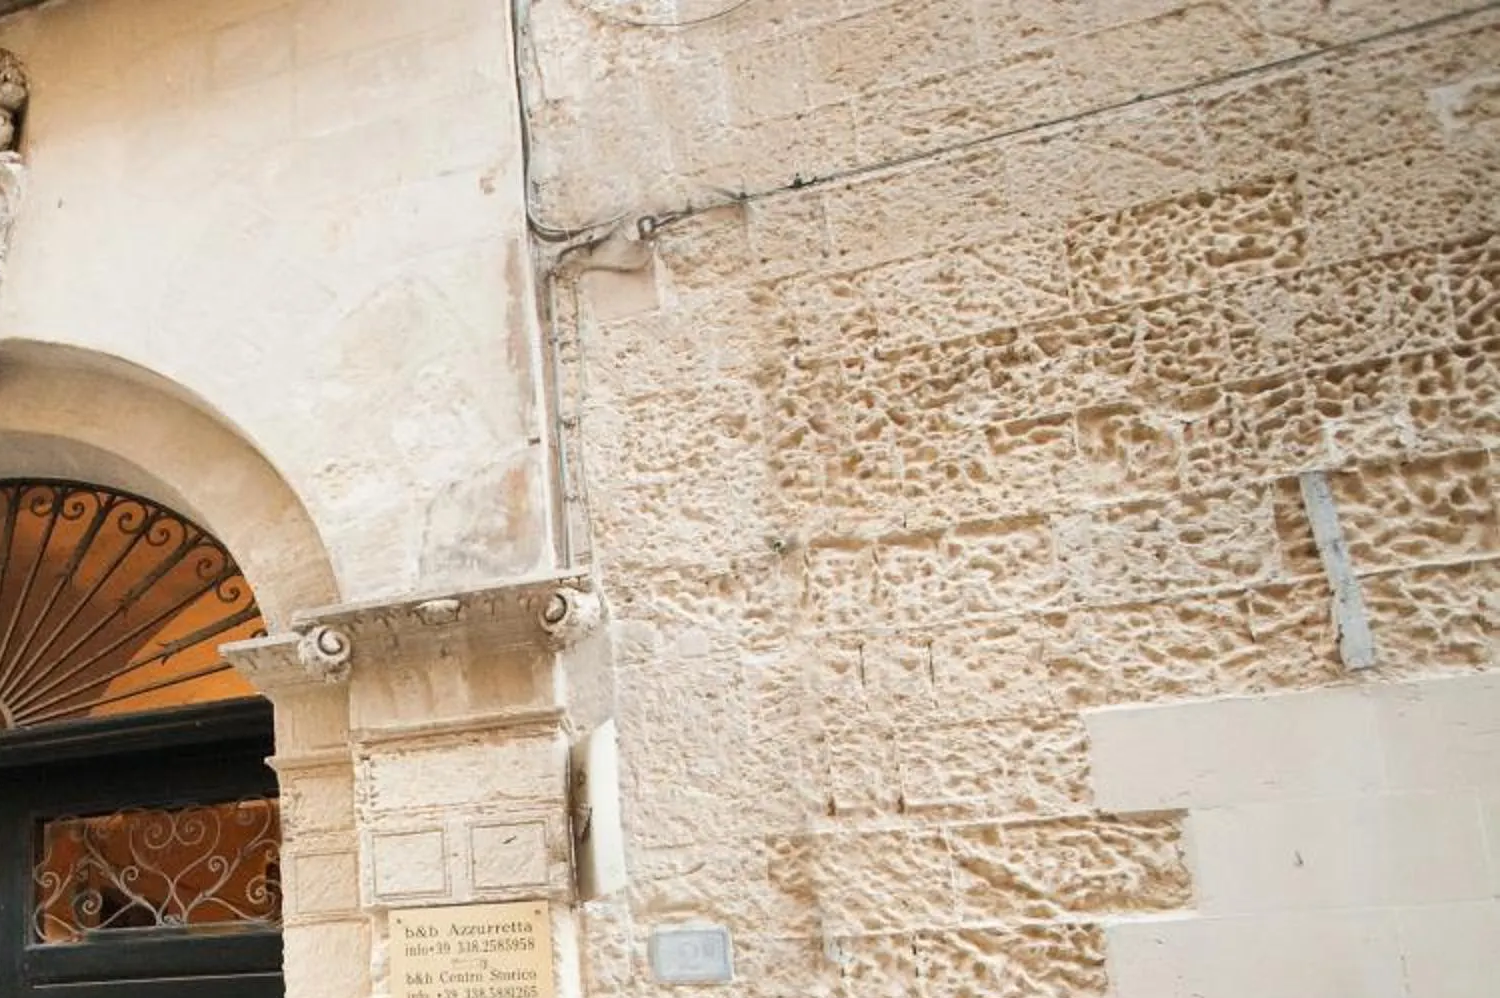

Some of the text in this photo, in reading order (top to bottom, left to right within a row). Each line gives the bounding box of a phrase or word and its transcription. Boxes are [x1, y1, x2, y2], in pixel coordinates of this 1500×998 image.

[448, 921, 533, 936] Azzurretta
[439, 971, 483, 983] Centro
[489, 968, 537, 981] Storico
